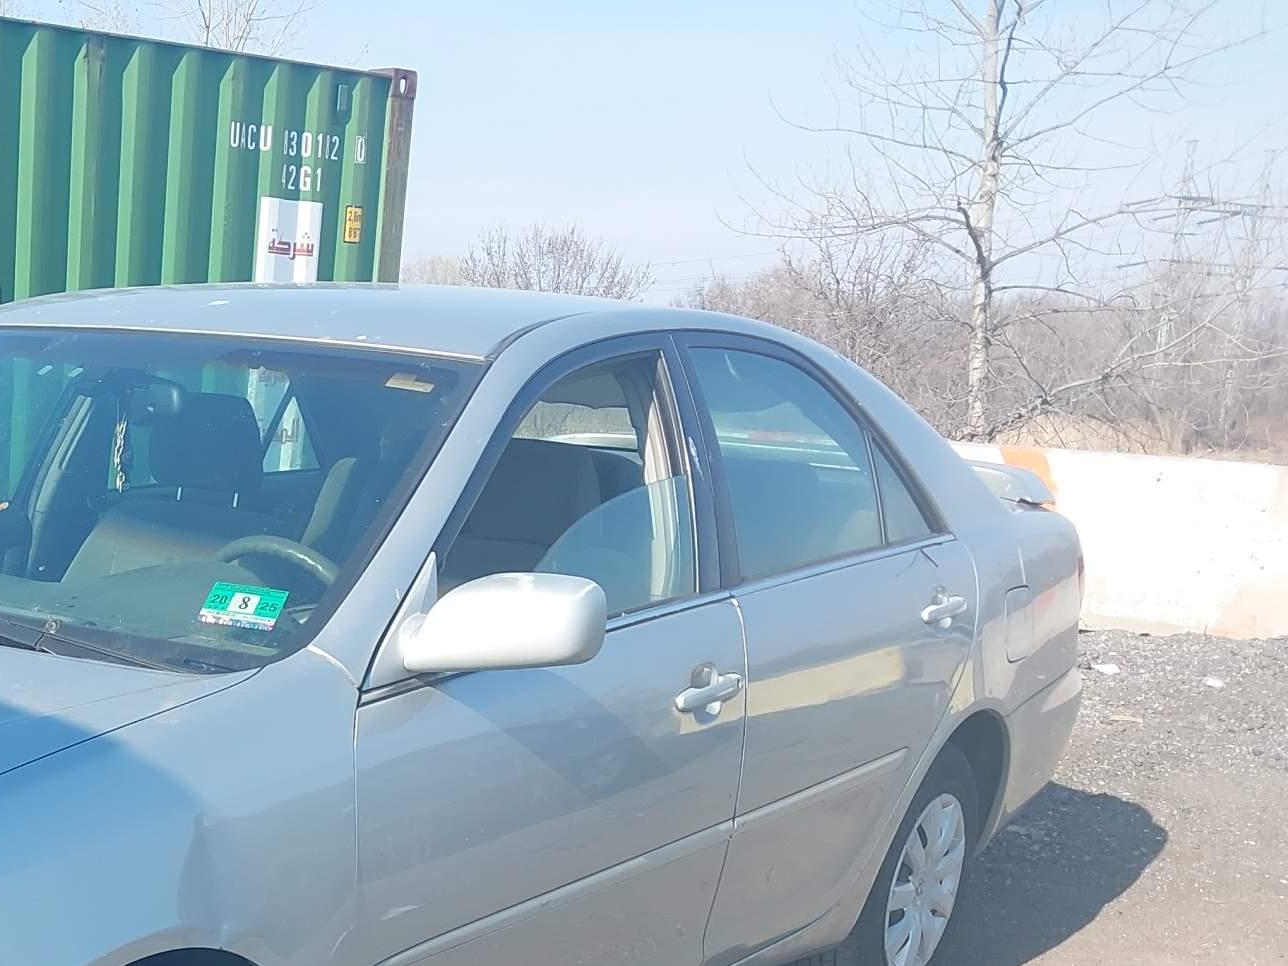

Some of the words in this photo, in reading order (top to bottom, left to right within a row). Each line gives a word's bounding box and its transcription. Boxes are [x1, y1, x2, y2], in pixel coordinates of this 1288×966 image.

[230, 121, 273, 151] UACU
[283, 129, 340, 161] 830182
[356, 136, 366, 162] 0
[281, 163, 322, 192] 42G1
[267, 228, 315, 261] شركة
[210, 594, 228, 605] 20
[238, 596, 251, 610] 8
[259, 602, 279, 613] 25
